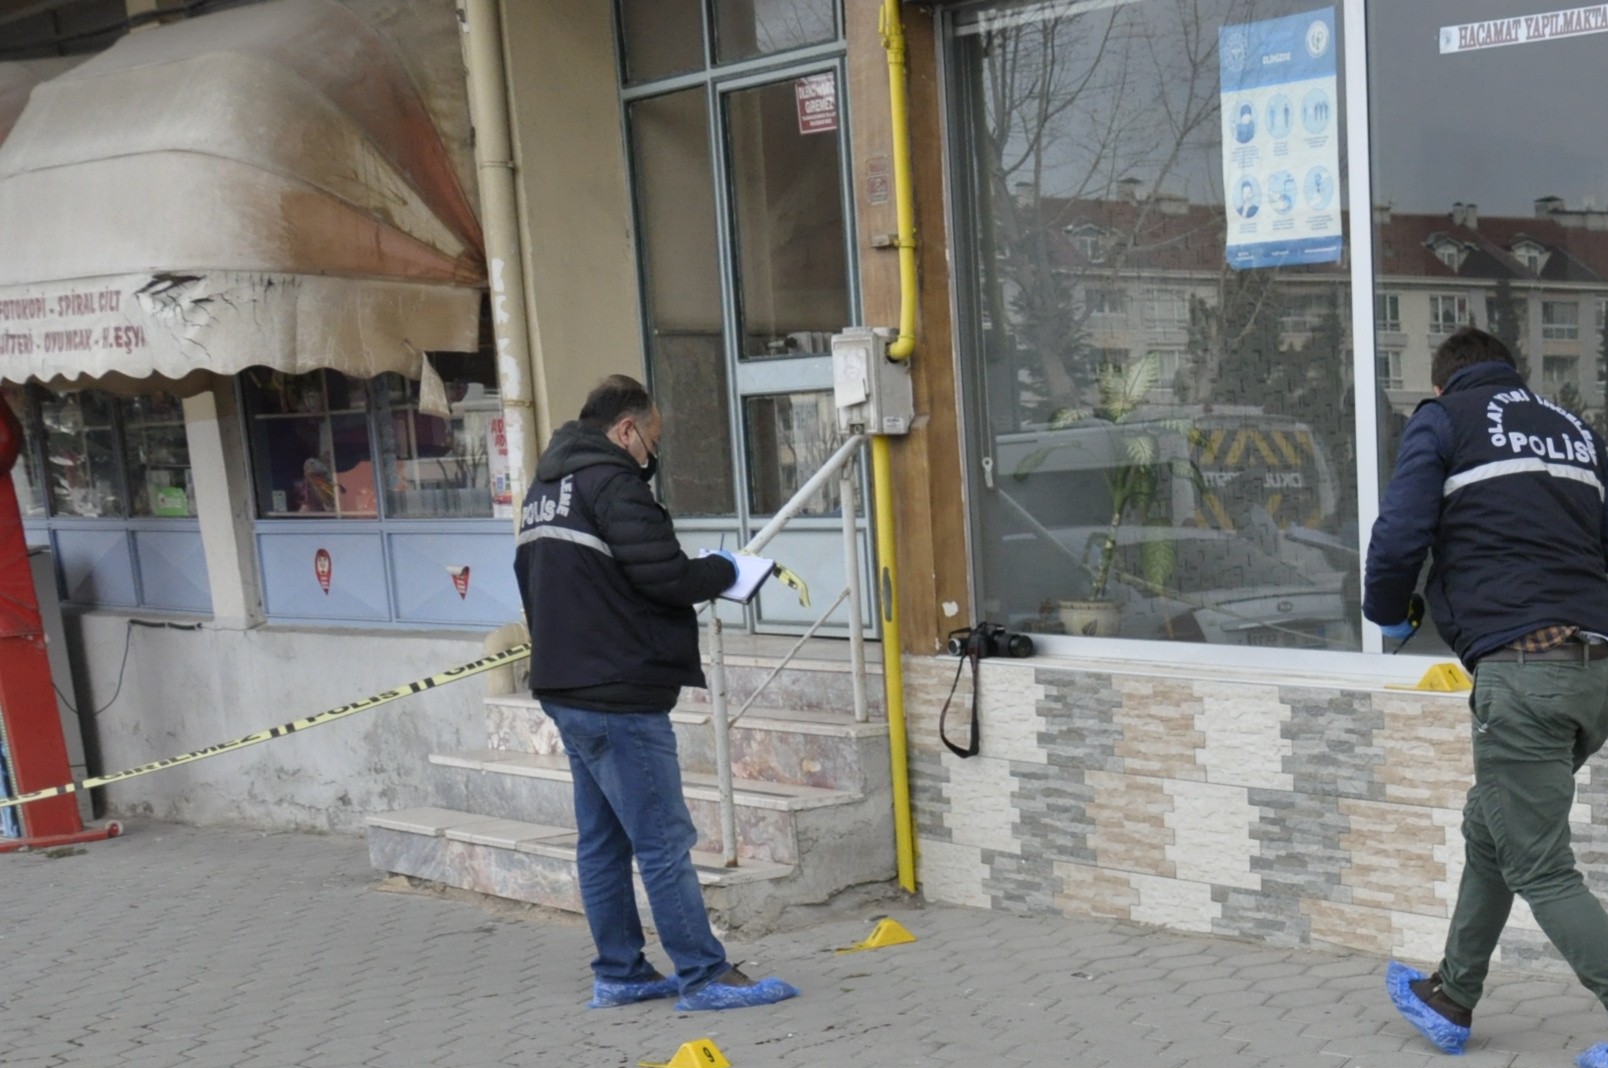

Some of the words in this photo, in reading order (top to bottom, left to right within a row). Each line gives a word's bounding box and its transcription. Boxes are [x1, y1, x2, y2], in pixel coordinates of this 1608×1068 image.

[1487, 401, 1506, 447] OLAY
[1508, 432, 1591, 463] POLİS
[521, 494, 556, 528] POLİS
[703, 1046, 715, 1063] 9
